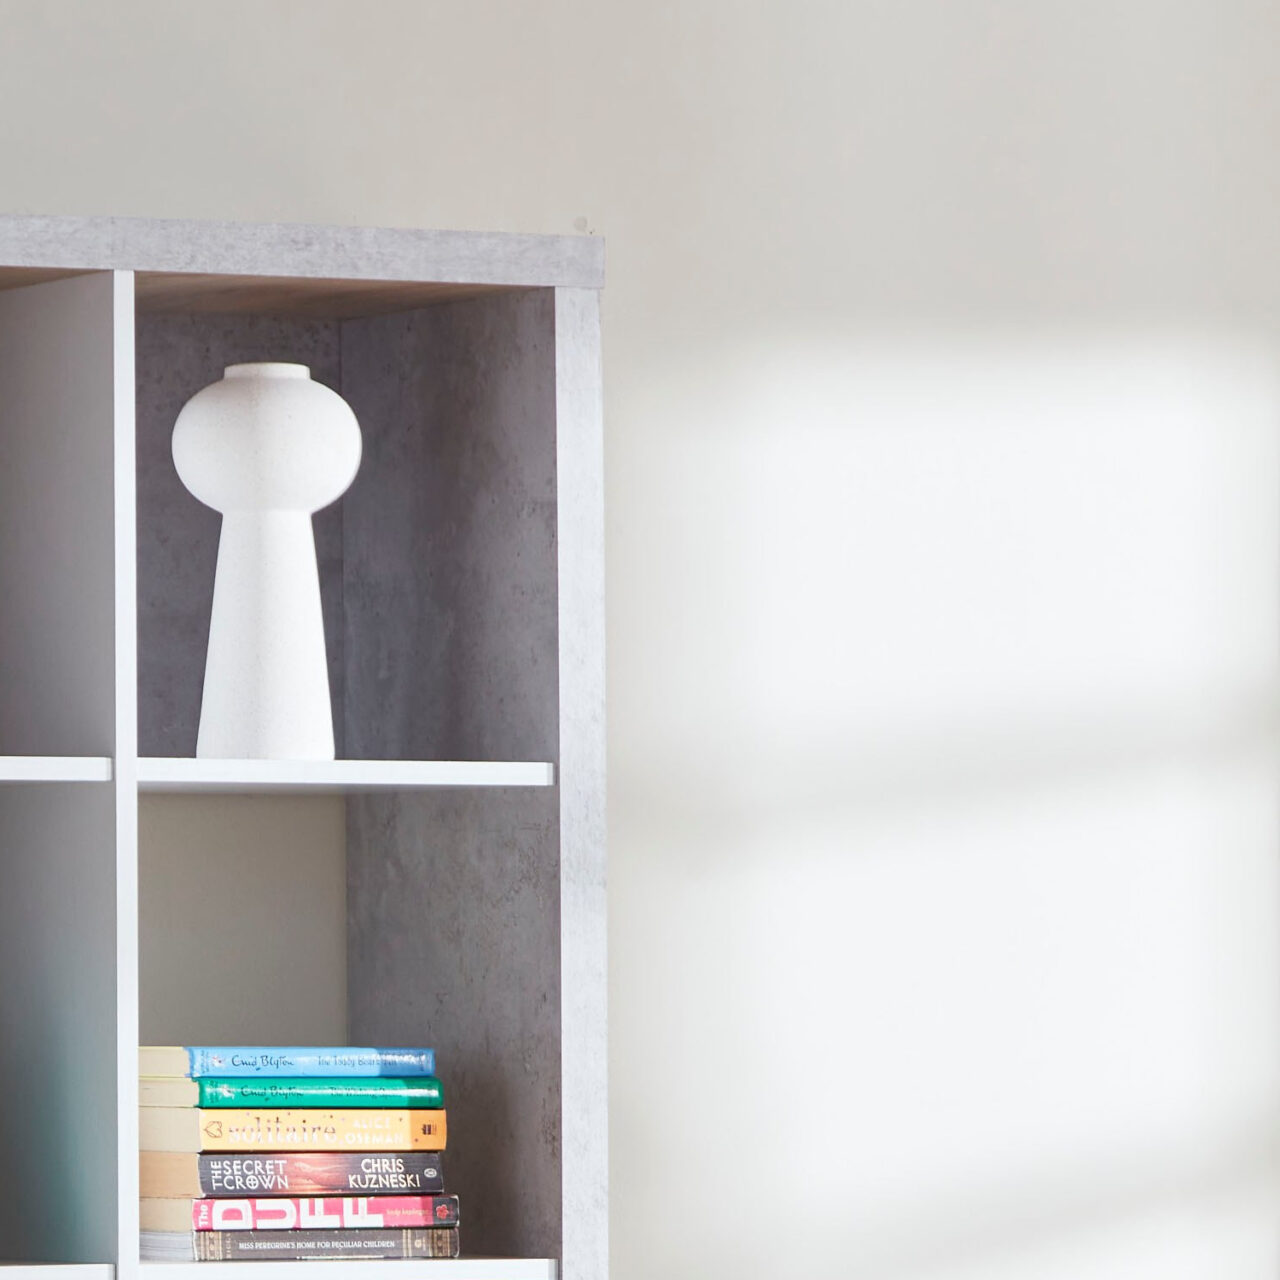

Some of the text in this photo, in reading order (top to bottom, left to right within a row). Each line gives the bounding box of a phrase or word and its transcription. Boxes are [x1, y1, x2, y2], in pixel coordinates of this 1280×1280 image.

[231, 1054, 295, 1069] Enid Blyton
[223, 1159, 288, 1175] SECRET
[361, 1158, 404, 1173] CHRIS
[211, 1160, 222, 1190] THE
[223, 1175, 289, 1190] CROWN
[348, 1173, 420, 1188] KUZNESKI
[198, 1204, 209, 1226] The
[239, 1241, 253, 1250] MISS
[297, 1241, 316, 1250] HOME
[318, 1241, 330, 1250] FOR
[363, 1241, 395, 1250] CHILDREN
